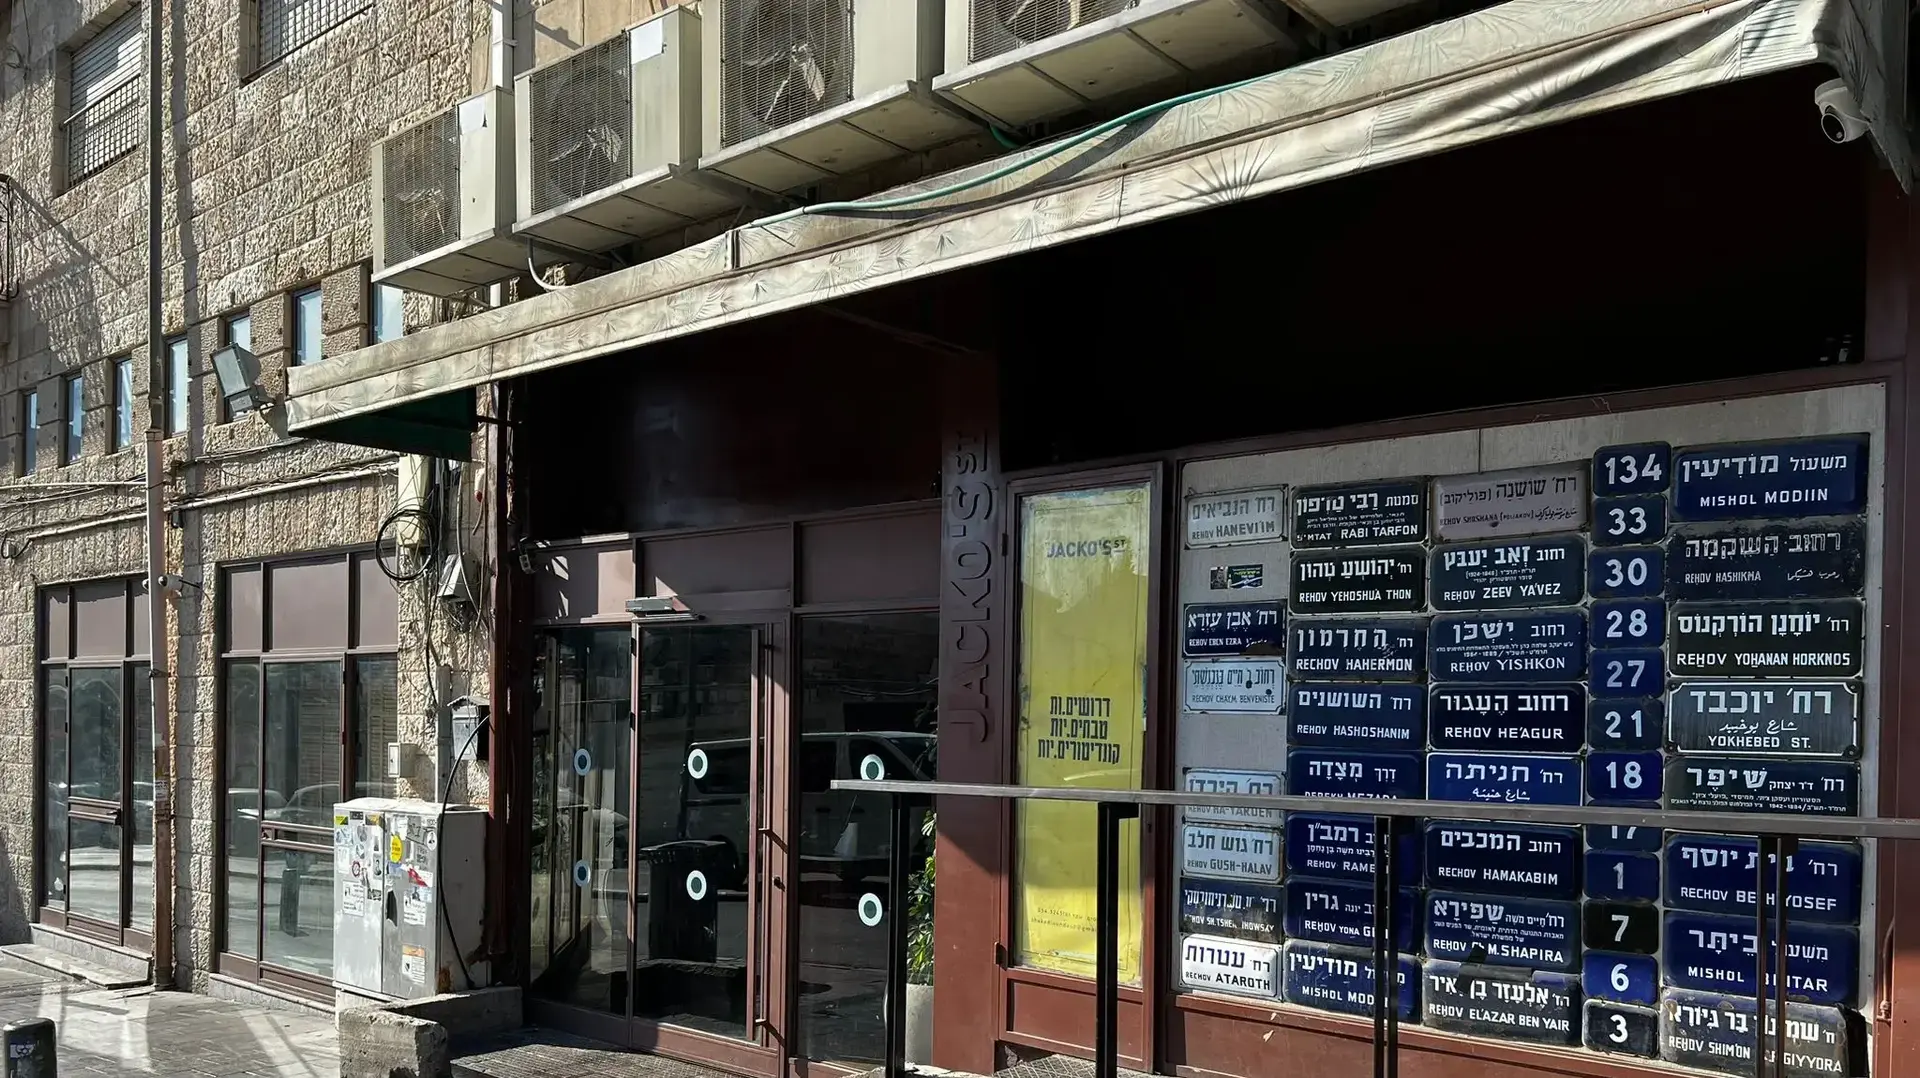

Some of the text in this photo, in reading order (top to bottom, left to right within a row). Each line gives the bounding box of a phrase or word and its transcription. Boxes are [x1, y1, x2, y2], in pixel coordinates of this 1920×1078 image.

[1605, 453, 1662, 485] 134
[1700, 488, 1828, 507] MISHOL MODIIN
[1608, 507, 1647, 535] 33
[1191, 530, 1214, 540] REHOV
[1341, 527, 1369, 539] RABI
[1373, 525, 1418, 537] TARFON
[1046, 539, 1112, 558] JACKO'S
[1788, 532, 1841, 553] רחוב
[1536, 548, 1565, 561] רחוב
[1605, 558, 1648, 588] 30
[1299, 589, 1412, 602] REHOV THON
[1483, 586, 1513, 599] ZEEV
[951, 480, 993, 742] JACKO'S
[1530, 624, 1565, 637] רחוב
[1606, 609, 1648, 638] 28
[1296, 658, 1413, 671] RECHOV HAHERMON
[1496, 657, 1566, 671] YISHKON
[1792, 653, 1850, 666] HORKNOS
[1606, 660, 1646, 688] 27
[1298, 691, 1382, 709] השושנים
[1517, 695, 1569, 711] רחוב
[1690, 688, 1832, 714] רח' יוכבד
[1297, 725, 1410, 740] REHOV HASHOSHANIM
[1445, 727, 1492, 738] REHOV
[1605, 710, 1642, 738] 21
[1709, 735, 1811, 748] YOKHEBED ST.
[1445, 763, 1530, 782] חניתה
[1606, 761, 1643, 789] 18
[1441, 830, 1561, 854] רחוב המכבים
[1187, 859, 1208, 869] REHOV
[1307, 859, 1337, 869] REHOV
[1681, 847, 1838, 877] רח' יוסף
[1438, 867, 1558, 886] RECHOV HAMAKABIM
[1613, 862, 1624, 889] 1
[1305, 892, 1339, 910] גרין
[1681, 887, 1728, 900] RECHOV
[1612, 915, 1630, 942] 7
[1185, 945, 1246, 969] עטרות
[1185, 971, 1271, 990] RECHOV ATAROTH
[1611, 964, 1630, 992] 6
[1688, 966, 1744, 982] MISHOL
[1302, 985, 1342, 1001] MISHOL
[1519, 1014, 1540, 1028] BEN
[1542, 1018, 1570, 1031] YAIR
[1609, 1014, 1629, 1043] 3
